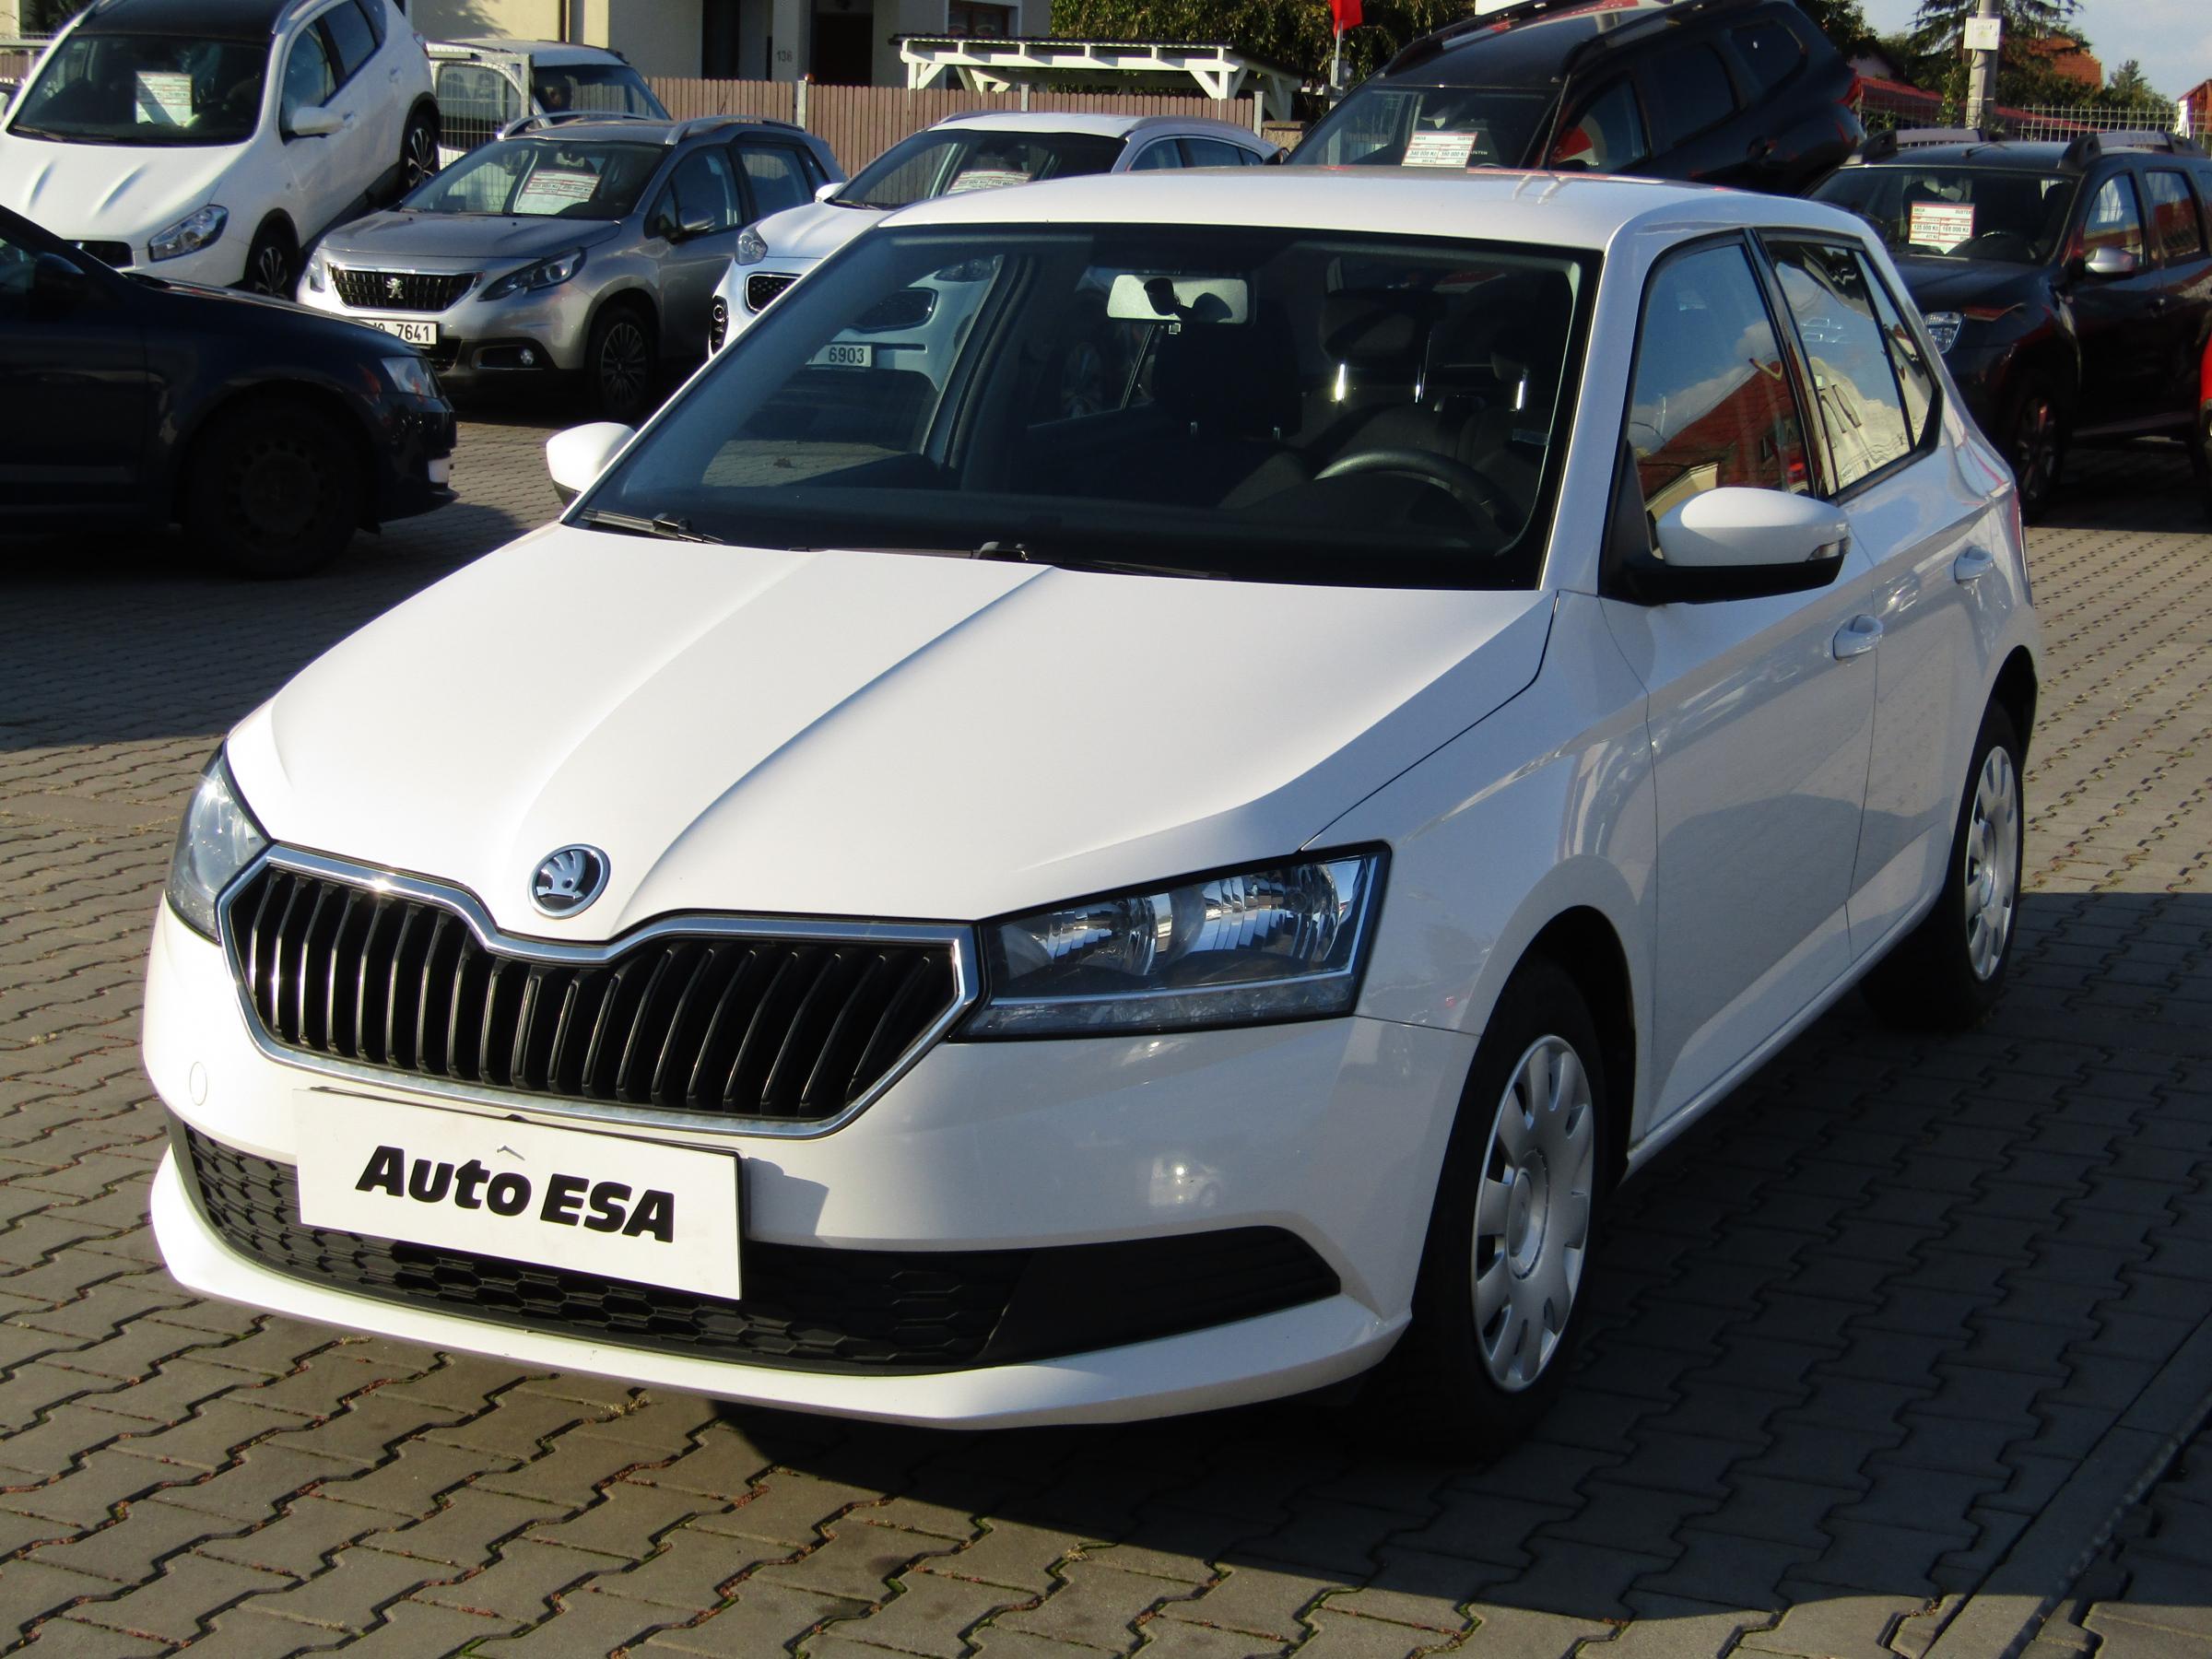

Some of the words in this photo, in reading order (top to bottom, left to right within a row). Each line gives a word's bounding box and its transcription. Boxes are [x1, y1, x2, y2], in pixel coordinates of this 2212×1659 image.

[396, 324, 429, 342] 7641
[829, 347, 865, 364] 6903
[355, 1145, 532, 1217] Auto
[539, 1173, 675, 1243] ESA
